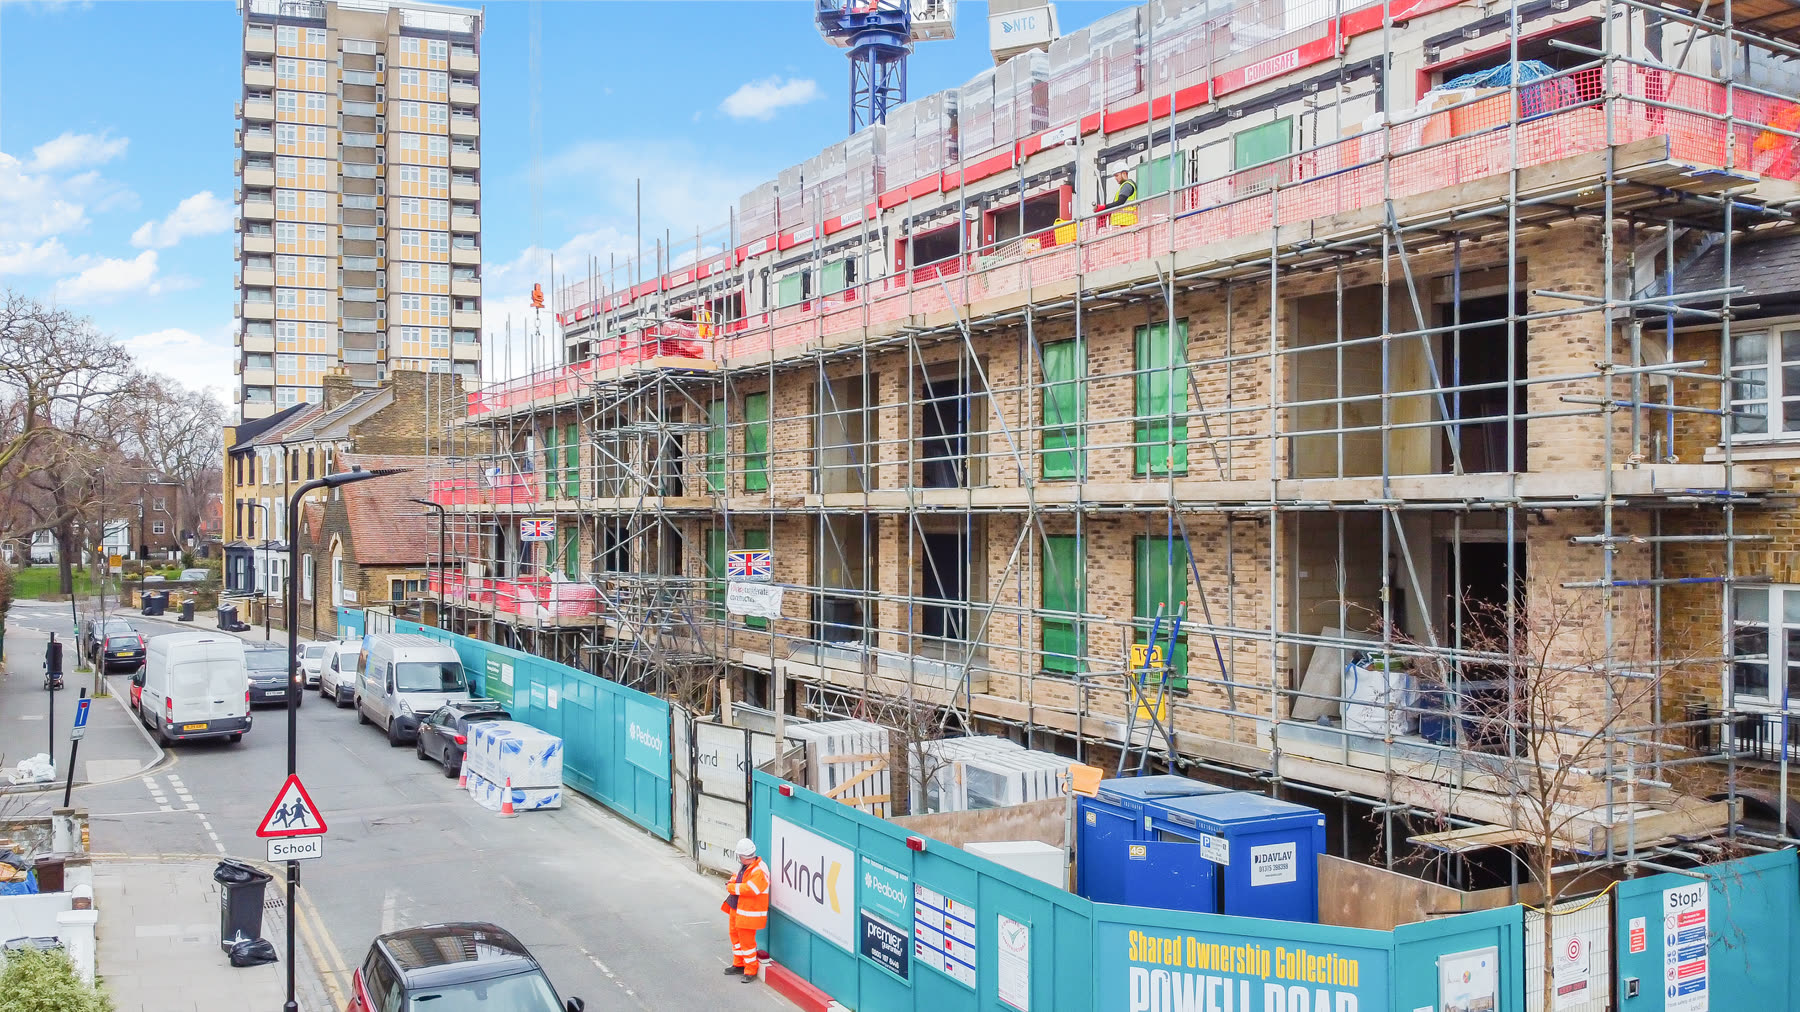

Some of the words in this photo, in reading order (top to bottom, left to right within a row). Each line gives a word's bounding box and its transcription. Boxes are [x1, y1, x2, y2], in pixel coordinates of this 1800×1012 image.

[1013, 16, 1035, 32] NTC
[1247, 52, 1295, 82] COMBISAFE
[636, 725, 663, 758] Peabody
[273, 841, 316, 855] School
[1262, 851, 1292, 863] DAVLAV
[781, 837, 824, 905] kind
[873, 876, 907, 910] Peabody
[1669, 887, 1702, 908] Stop!
[867, 921, 902, 949] premier
[1129, 930, 1182, 967] Shared
[1186, 937, 1271, 980] Ownership
[1275, 946, 1359, 987] Collection
